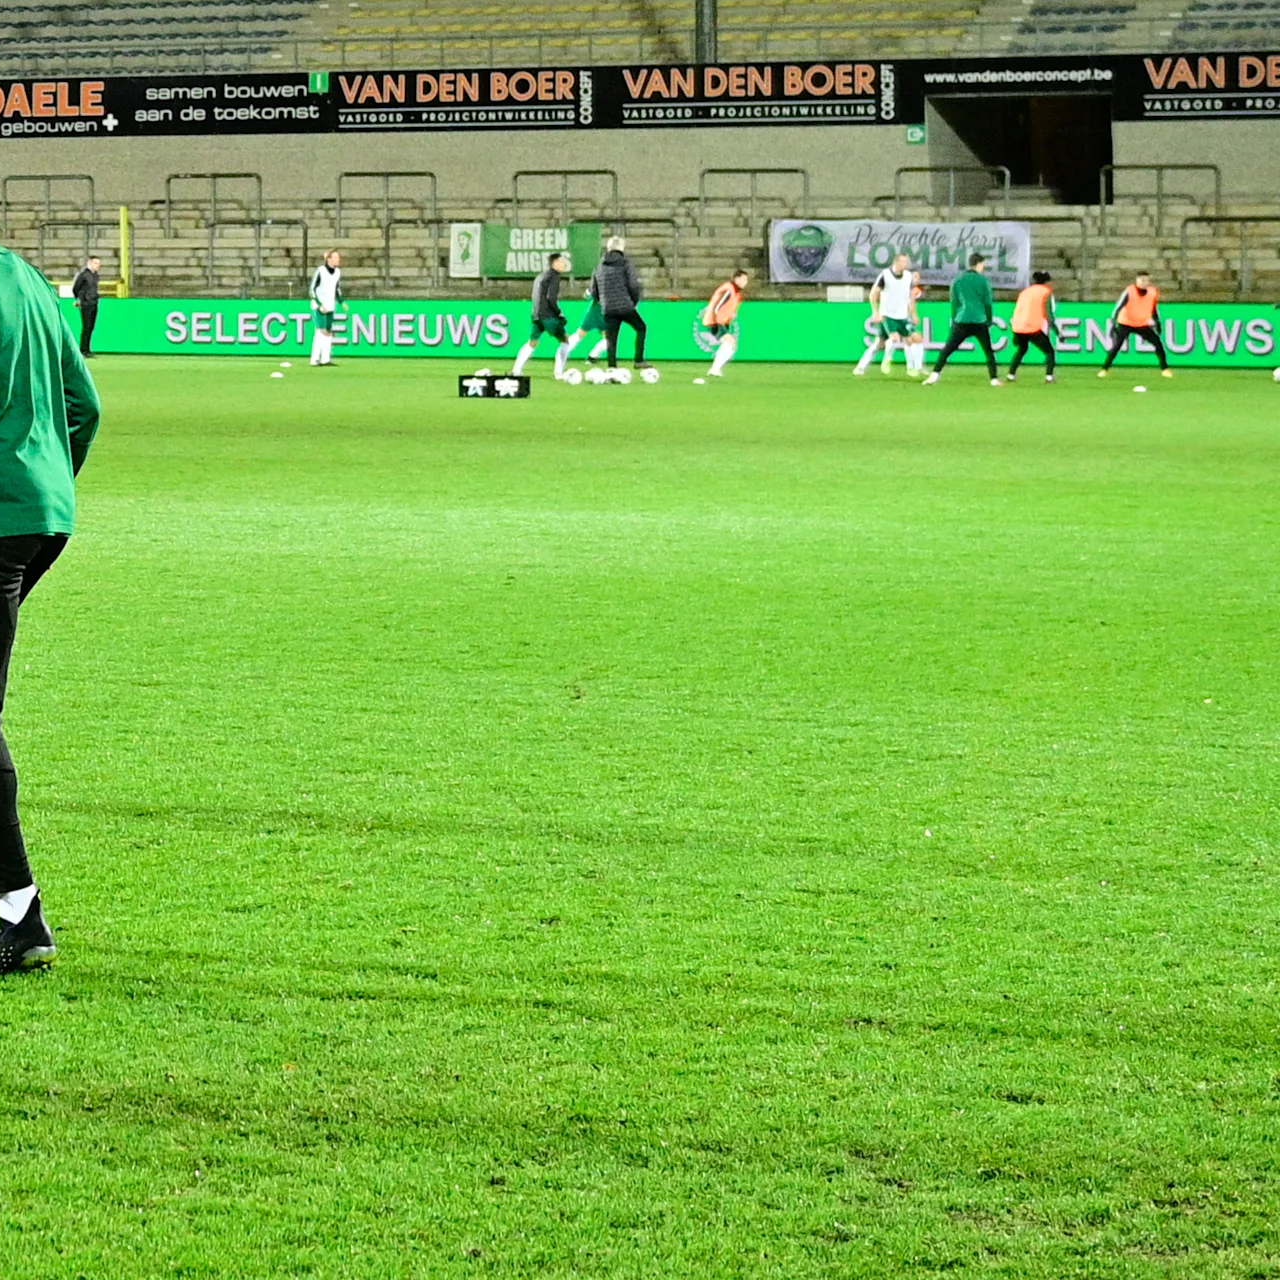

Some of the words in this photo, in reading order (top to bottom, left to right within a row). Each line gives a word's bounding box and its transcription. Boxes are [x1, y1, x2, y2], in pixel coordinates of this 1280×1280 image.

[623, 69, 694, 99] VAN
[704, 66, 772, 97] DEN
[784, 64, 875, 96] BOER
[924, 69, 1113, 83] www.vandenboerconcept.be
[1144, 57, 1224, 89] VAN
[145, 86, 218, 101] samen
[224, 82, 308, 99] bouwen
[339, 74, 407, 104] VAN
[415, 72, 479, 102] DEN
[489, 70, 575, 102] BOER
[579, 70, 593, 125] CONCEPT
[880, 63, 895, 120] CONCEPT
[135, 109, 175, 122] aan
[180, 105, 207, 122] de
[213, 104, 320, 121] toekomst
[623, 108, 692, 119] VASTGOED
[710, 104, 876, 117] PROJECTONTWIKKELING
[1144, 99, 1223, 111] VASTGOED
[339, 113, 404, 124] VASTGOED
[422, 110, 576, 122] PROJECTONTWIKKELING
[1, 119, 98, 137] gebouwen
[509, 228, 568, 250] GREEN
[505, 251, 572, 272] ANGES
[165, 311, 510, 346] SELECTENIEUWS
